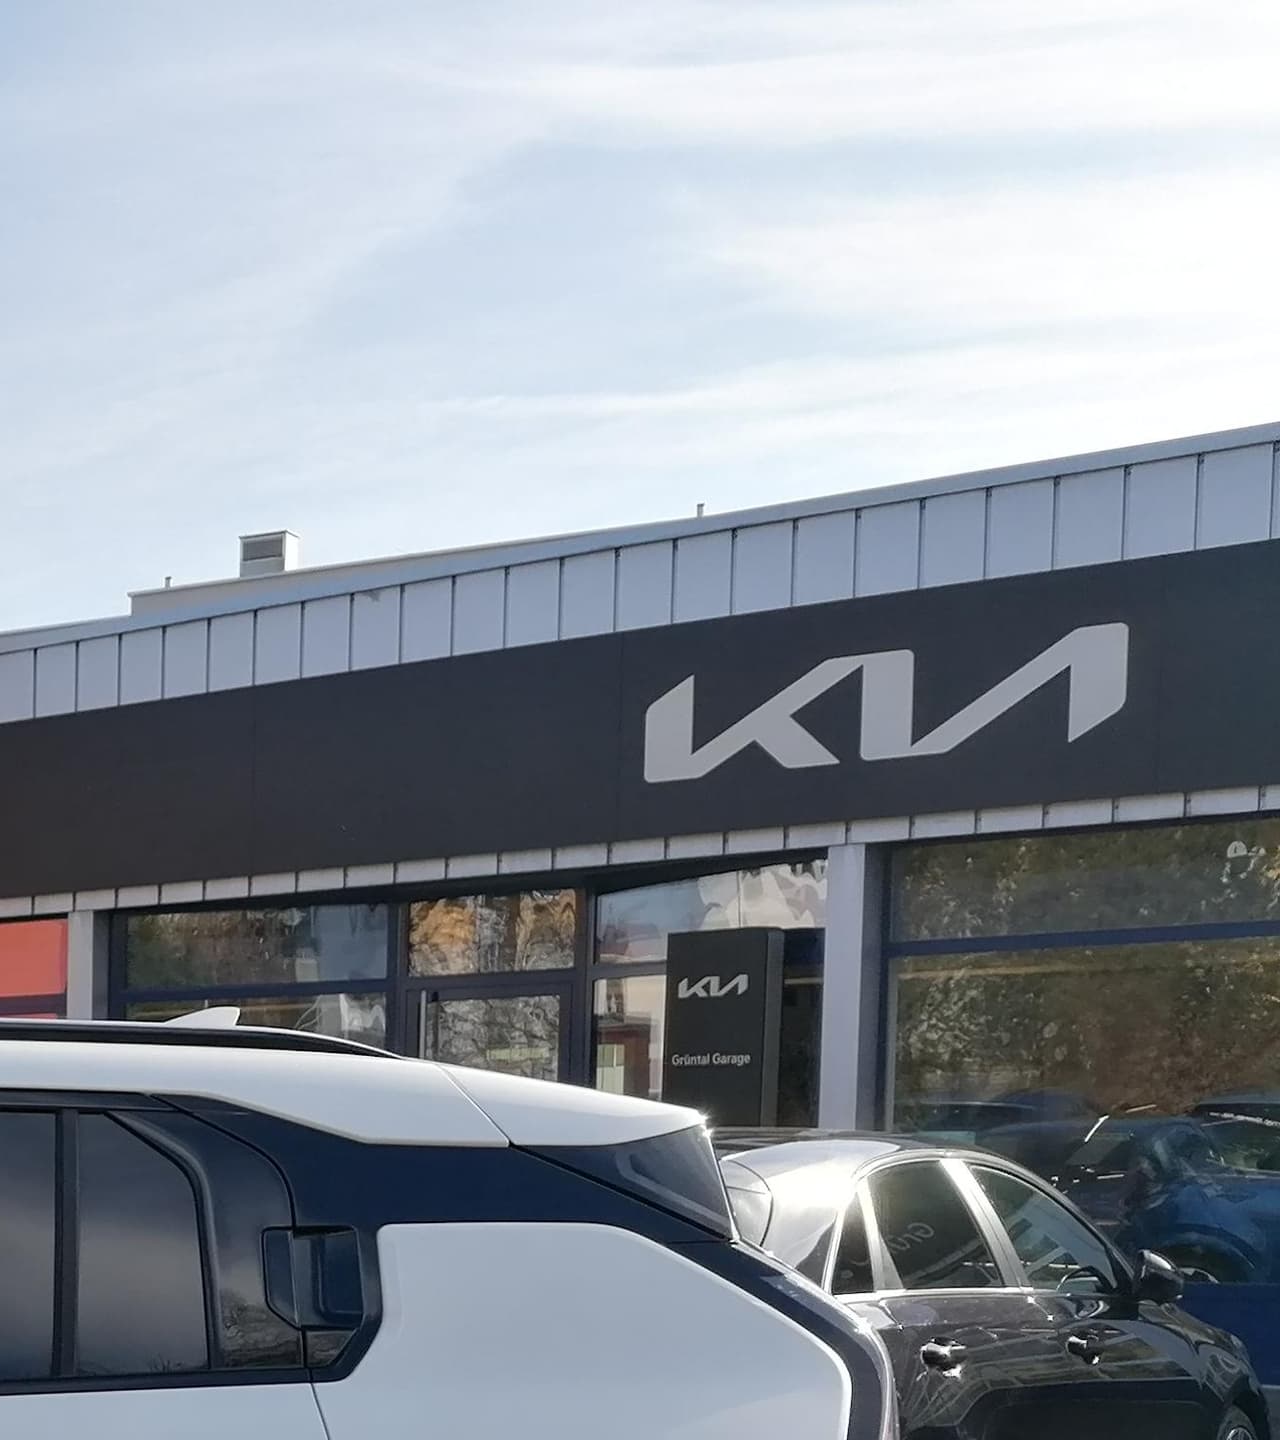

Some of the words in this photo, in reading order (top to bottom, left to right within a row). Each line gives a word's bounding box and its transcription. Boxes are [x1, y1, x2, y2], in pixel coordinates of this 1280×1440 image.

[643, 621, 1130, 783] KIA
[678, 973, 749, 998] KIA
[671, 1052, 710, 1066] Grüntal
[712, 1052, 751, 1066] Garage
